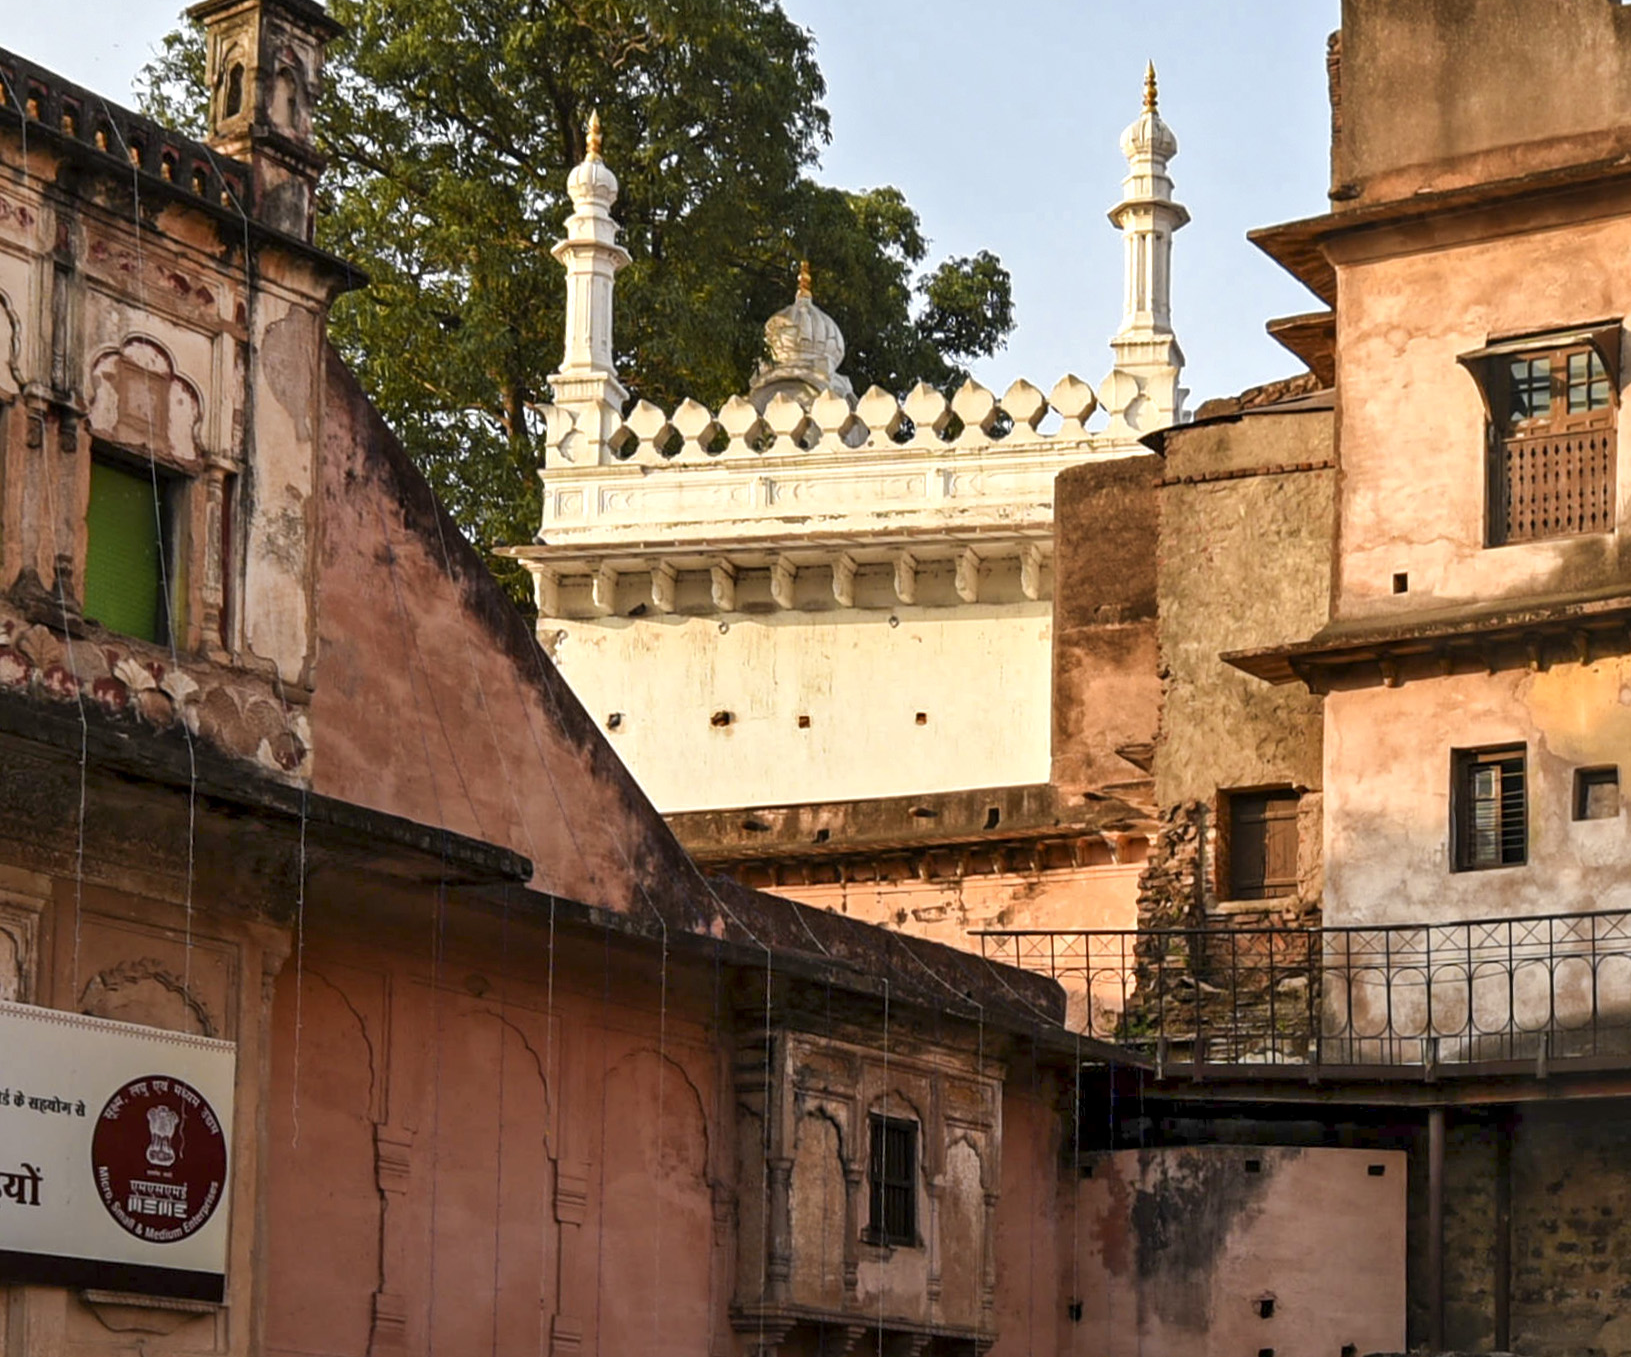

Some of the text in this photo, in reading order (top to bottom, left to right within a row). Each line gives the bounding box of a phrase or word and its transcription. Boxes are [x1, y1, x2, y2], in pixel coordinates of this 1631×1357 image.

[13, 1090, 25, 1107] के
[28, 1095, 72, 1116] सहयोग
[75, 1099, 86, 1117] से
[111, 1201, 136, 1231] Small
[135, 1223, 144, 1236] &
[144, 1226, 183, 1241] Medium
[182, 1181, 220, 1234] Enterprises
